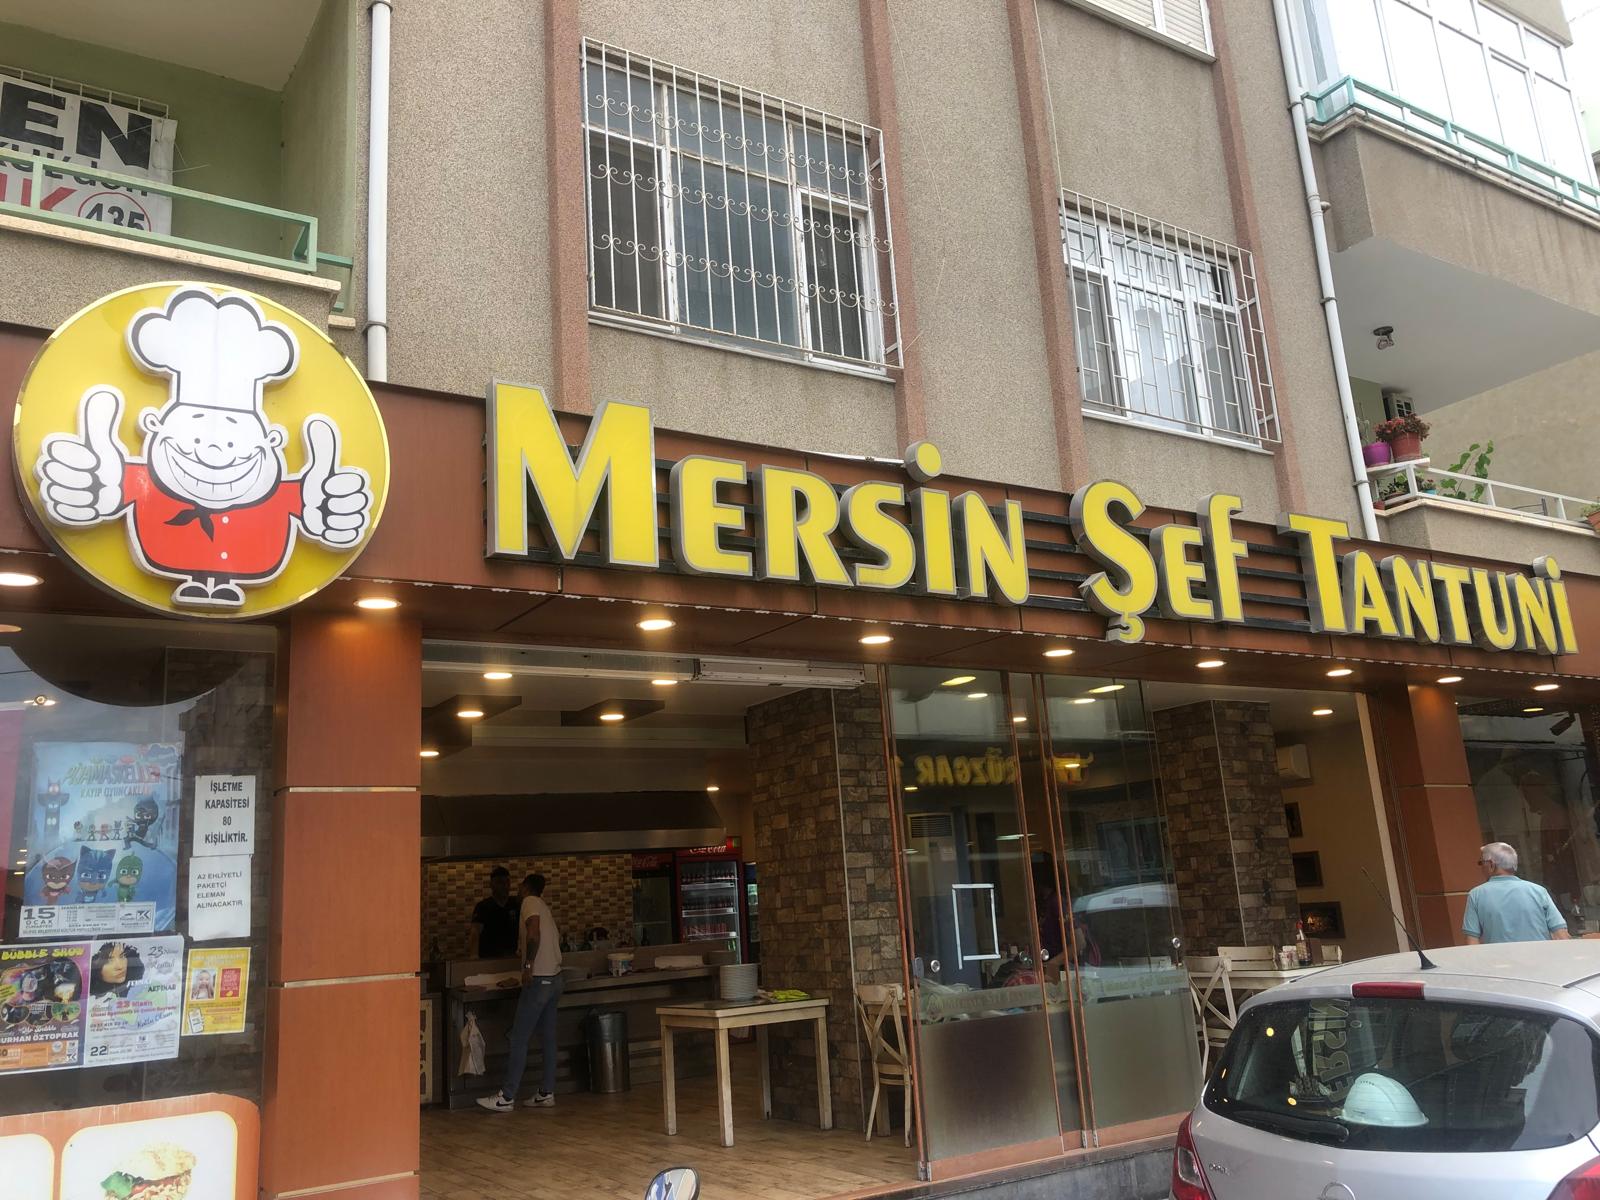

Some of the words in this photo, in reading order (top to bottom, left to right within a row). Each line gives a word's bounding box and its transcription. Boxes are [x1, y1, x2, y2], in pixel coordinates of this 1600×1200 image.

[210, 781, 243, 794] İŞLETME
[205, 797, 250, 810] KAPASİTESİ
[222, 816, 232, 826] 80
[205, 832, 248, 846] KİŞİLİKTİR.
[207, 871, 242, 880] EHLİYETLİ
[197, 881, 227, 889] PAKETÇİ
[23, 907, 56, 920] 15
[1, 949, 48, 960] BUBBLE
[33, 1031, 79, 1041] ÖZTOPRAK
[89, 1045, 107, 1056] 22
